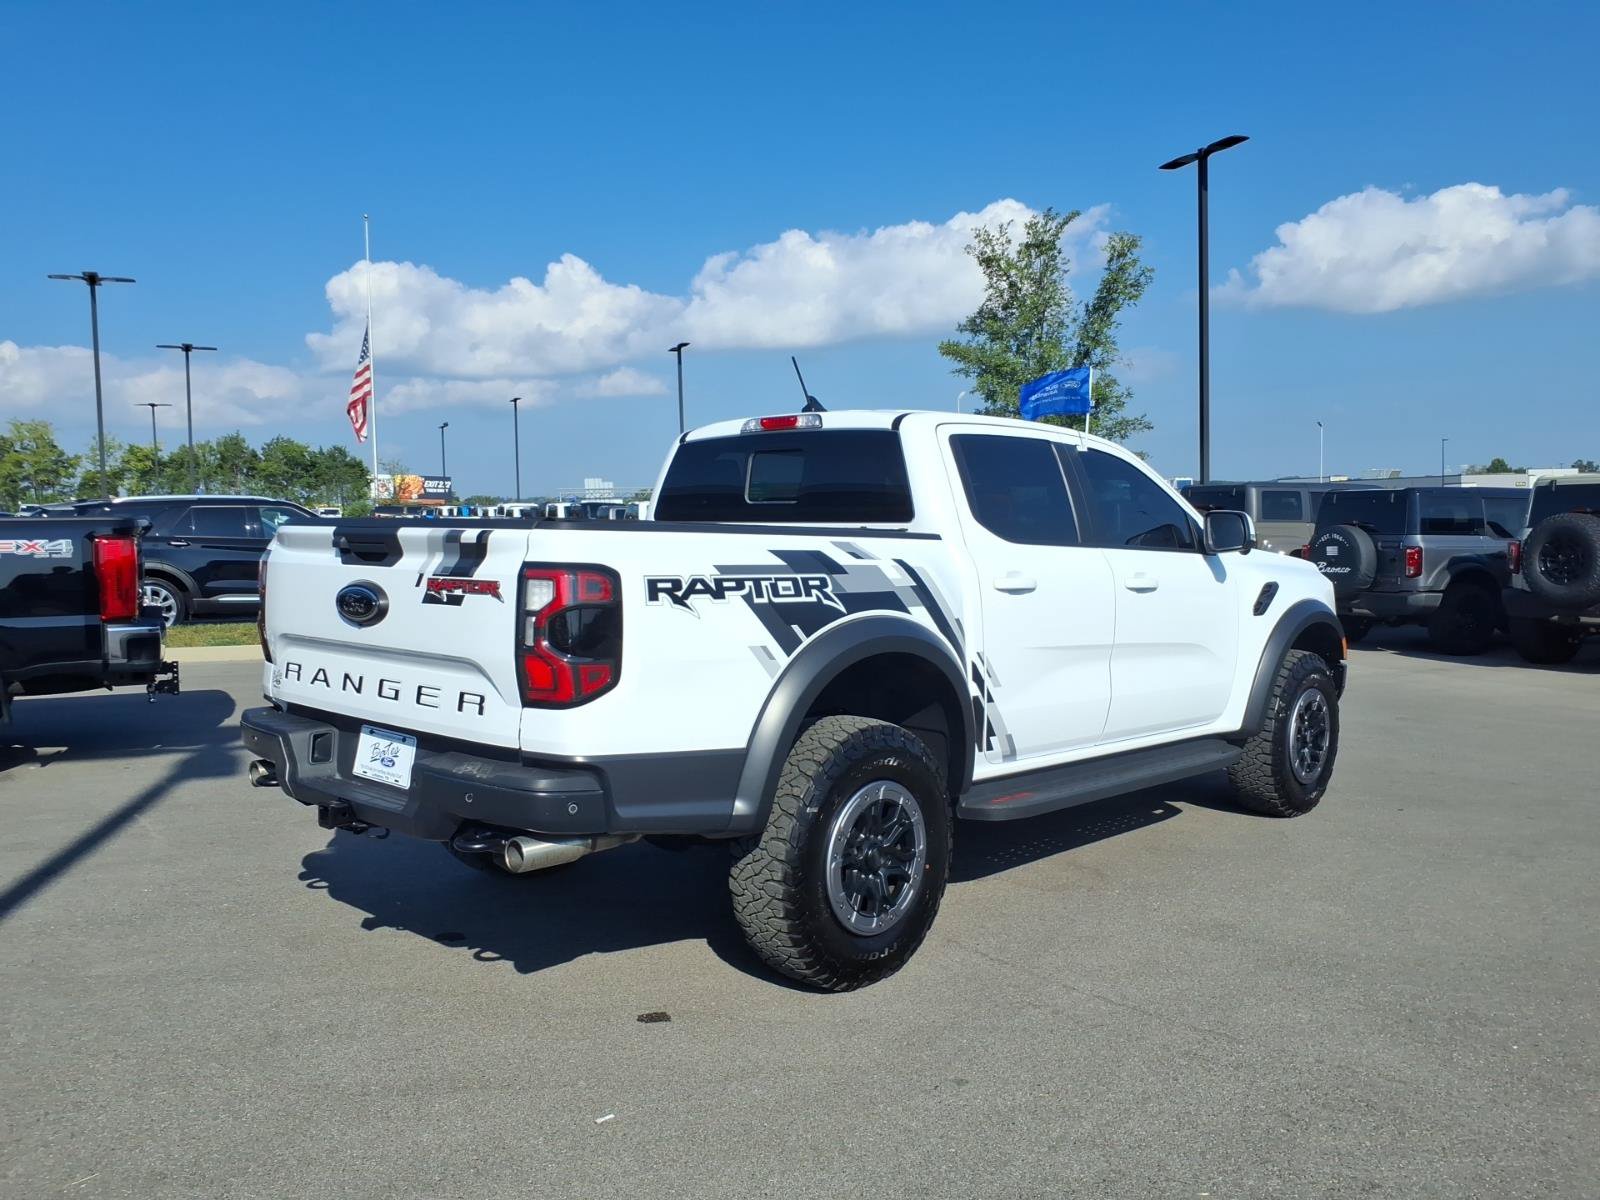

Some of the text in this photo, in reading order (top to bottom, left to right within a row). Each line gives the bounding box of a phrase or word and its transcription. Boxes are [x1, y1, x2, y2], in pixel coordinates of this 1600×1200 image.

[1317, 561, 1351, 573] Bronco
[427, 578, 503, 602] RAPTOR
[645, 574, 848, 618] RAPTOR
[284, 662, 486, 716] RANGER
